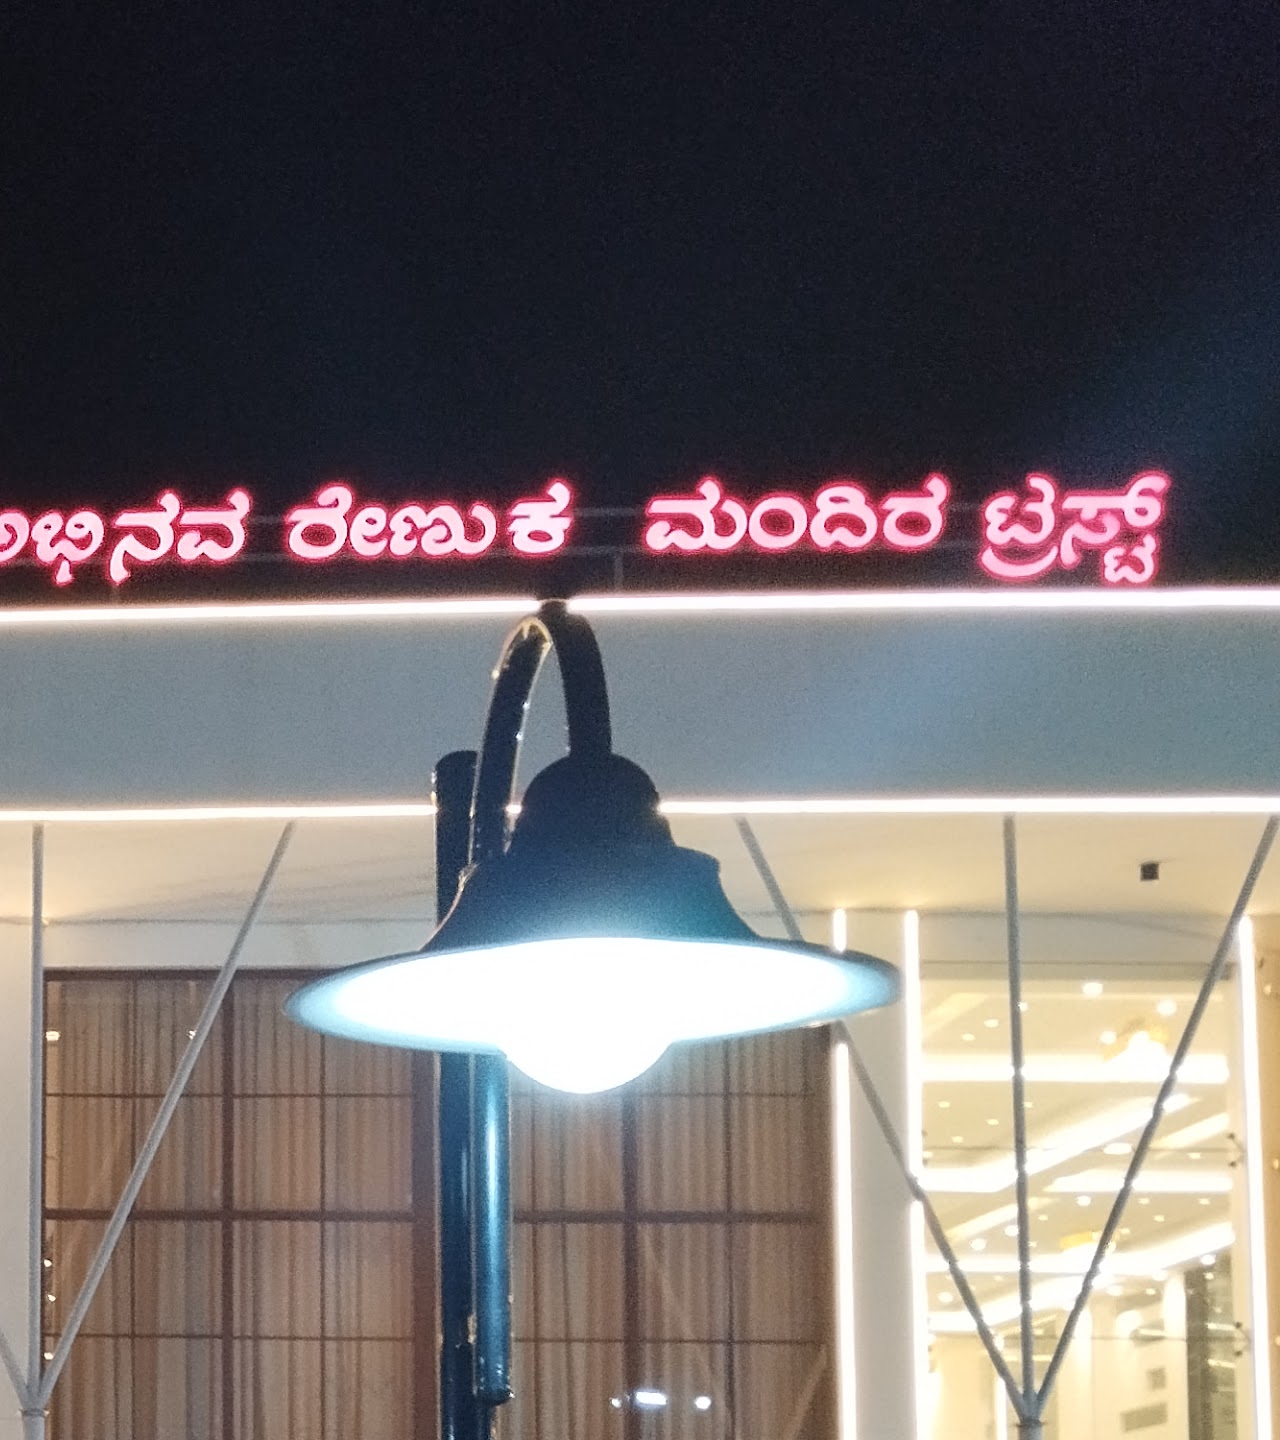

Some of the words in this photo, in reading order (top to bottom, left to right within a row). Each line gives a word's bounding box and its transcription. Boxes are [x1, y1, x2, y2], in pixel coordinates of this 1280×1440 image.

[284, 478, 574, 563] ರೇಣುಕ
[642, 473, 951, 555] ಮಂದಿರ
[979, 471, 1171, 583] ಟ್ರಸ್ಟ್
